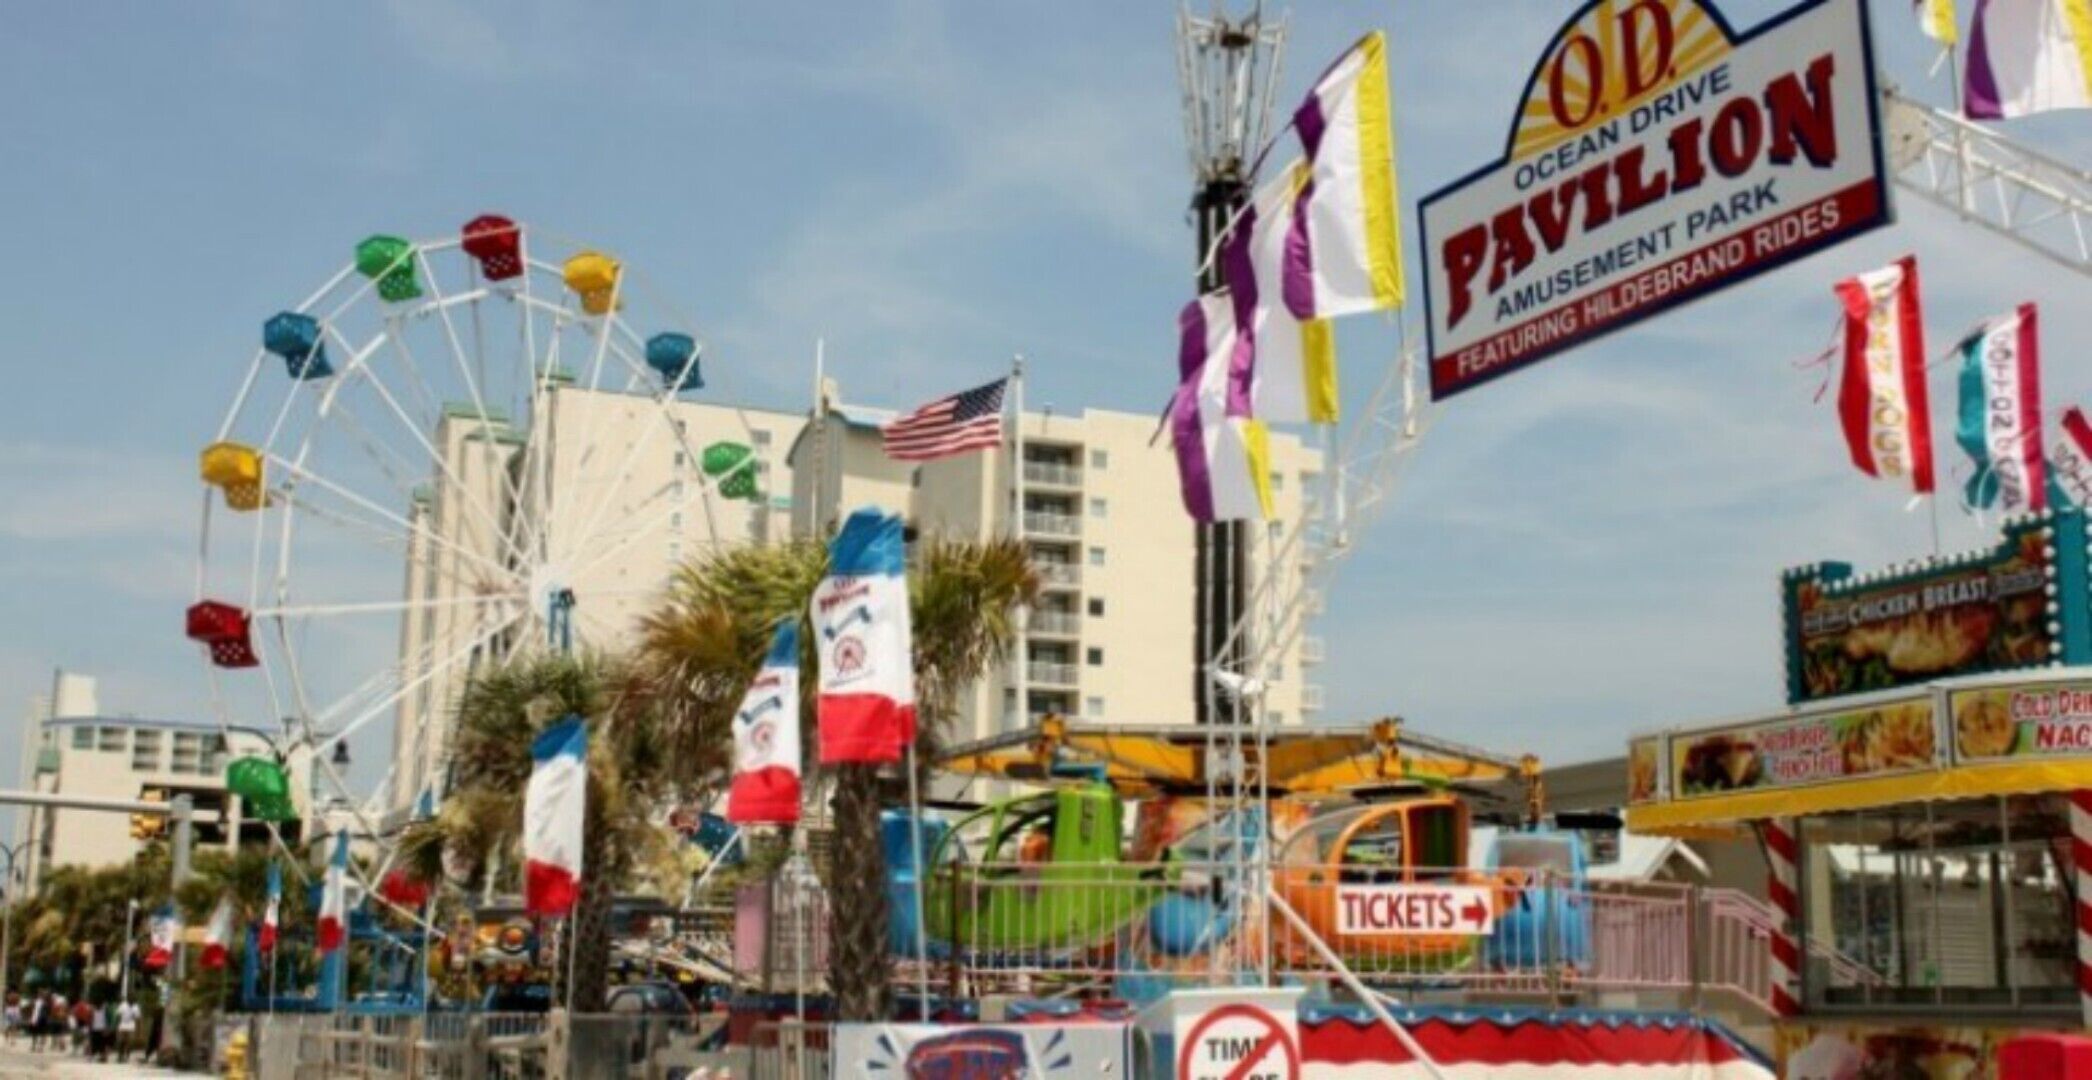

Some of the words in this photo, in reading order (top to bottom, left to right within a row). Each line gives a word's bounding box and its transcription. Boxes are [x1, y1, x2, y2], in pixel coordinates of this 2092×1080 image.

[1514, 119, 1619, 190] OCEAN
[1630, 64, 1731, 134] DRIVE
[1549, 0, 1676, 128] O.D.
[1443, 53, 1837, 331] PAVILION
[1496, 223, 1677, 320] AMUSEMENT
[1687, 178, 1779, 240] PARK
[1457, 307, 1578, 376] FEATURING
[1583, 239, 1746, 324] HILDEBRAND
[1753, 202, 1840, 258] RIDES
[1850, 593, 1919, 626] CHICKEN
[1922, 577, 1988, 612] BREAST
[2011, 692, 2051, 719] COLD
[2036, 723, 2092, 747] NAC
[1341, 892, 1456, 929] TICKETS
